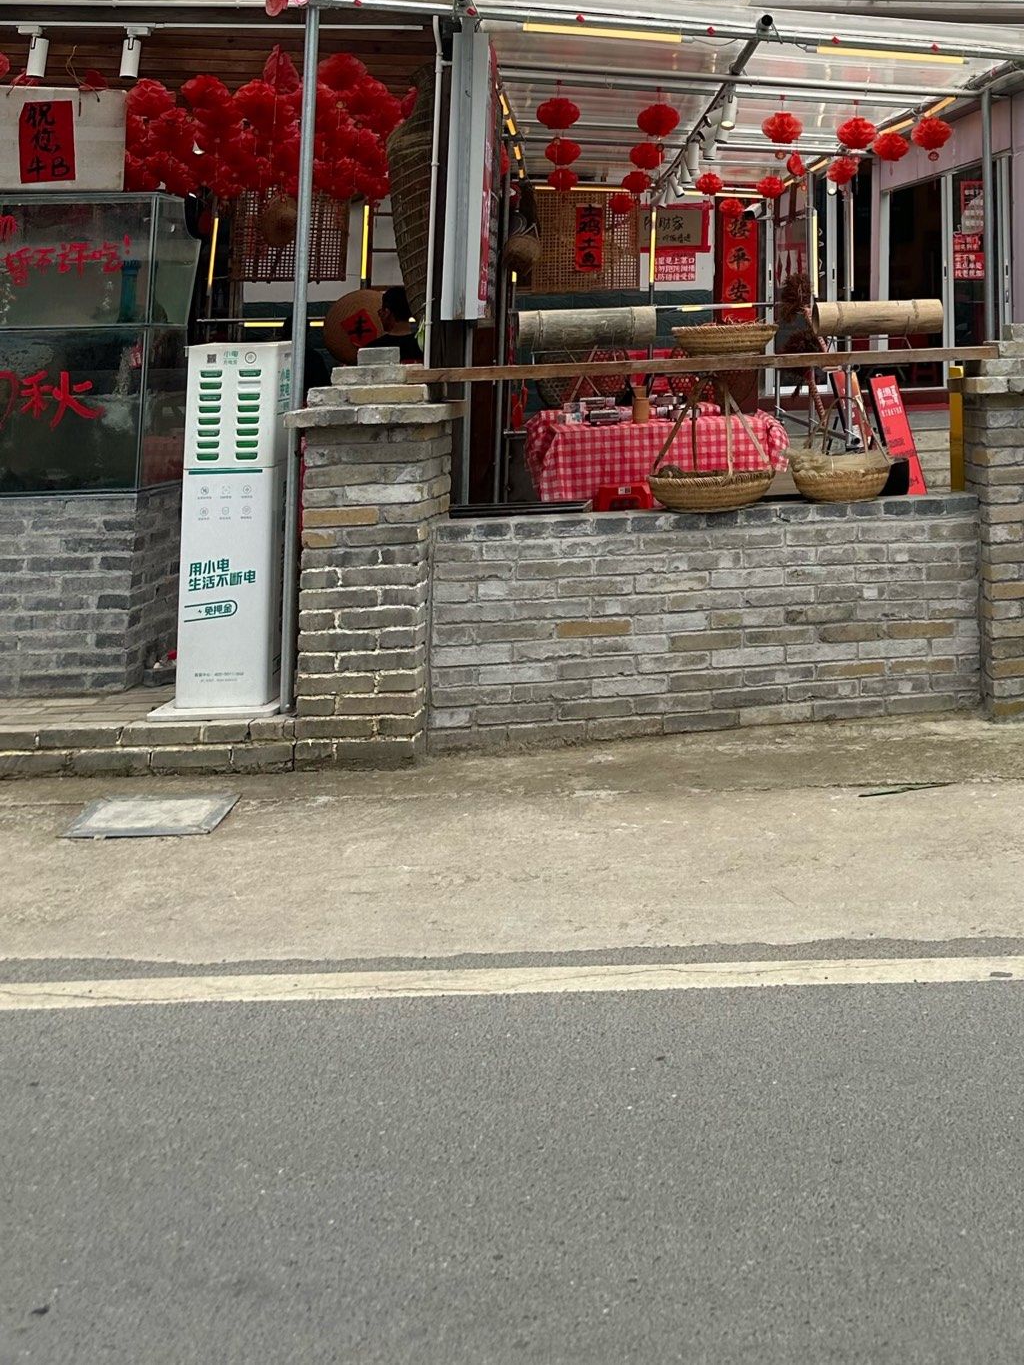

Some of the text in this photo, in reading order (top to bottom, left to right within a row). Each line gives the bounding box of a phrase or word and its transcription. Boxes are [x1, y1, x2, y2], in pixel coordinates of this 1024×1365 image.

[189, 558, 230, 577] 用小电
[204, 603, 233, 616] 免押金
